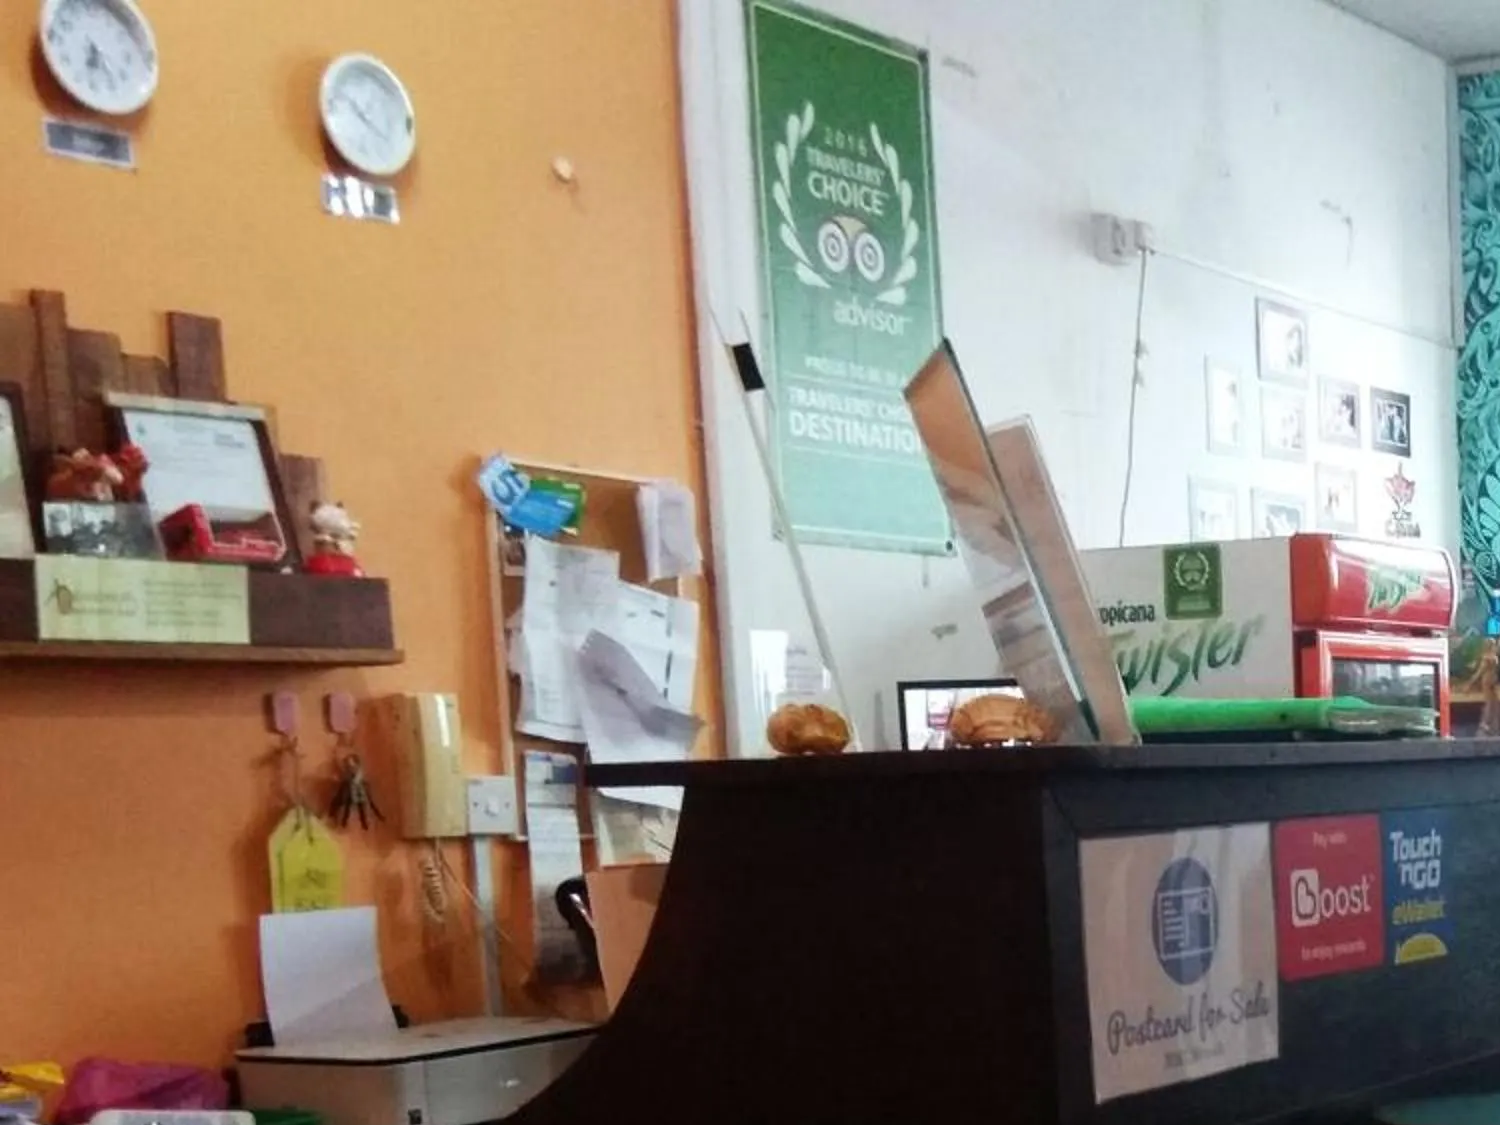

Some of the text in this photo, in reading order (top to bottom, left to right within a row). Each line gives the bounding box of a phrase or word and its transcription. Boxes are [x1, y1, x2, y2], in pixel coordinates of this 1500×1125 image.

[807, 170, 885, 216] CHOICE
[834, 296, 908, 336] advisor
[1099, 600, 1156, 627] opicana
[1390, 828, 1442, 862] Touch
[1292, 868, 1372, 927] Boost
[1107, 995, 1195, 1055] Postcard
[1199, 991, 1227, 1043] for
